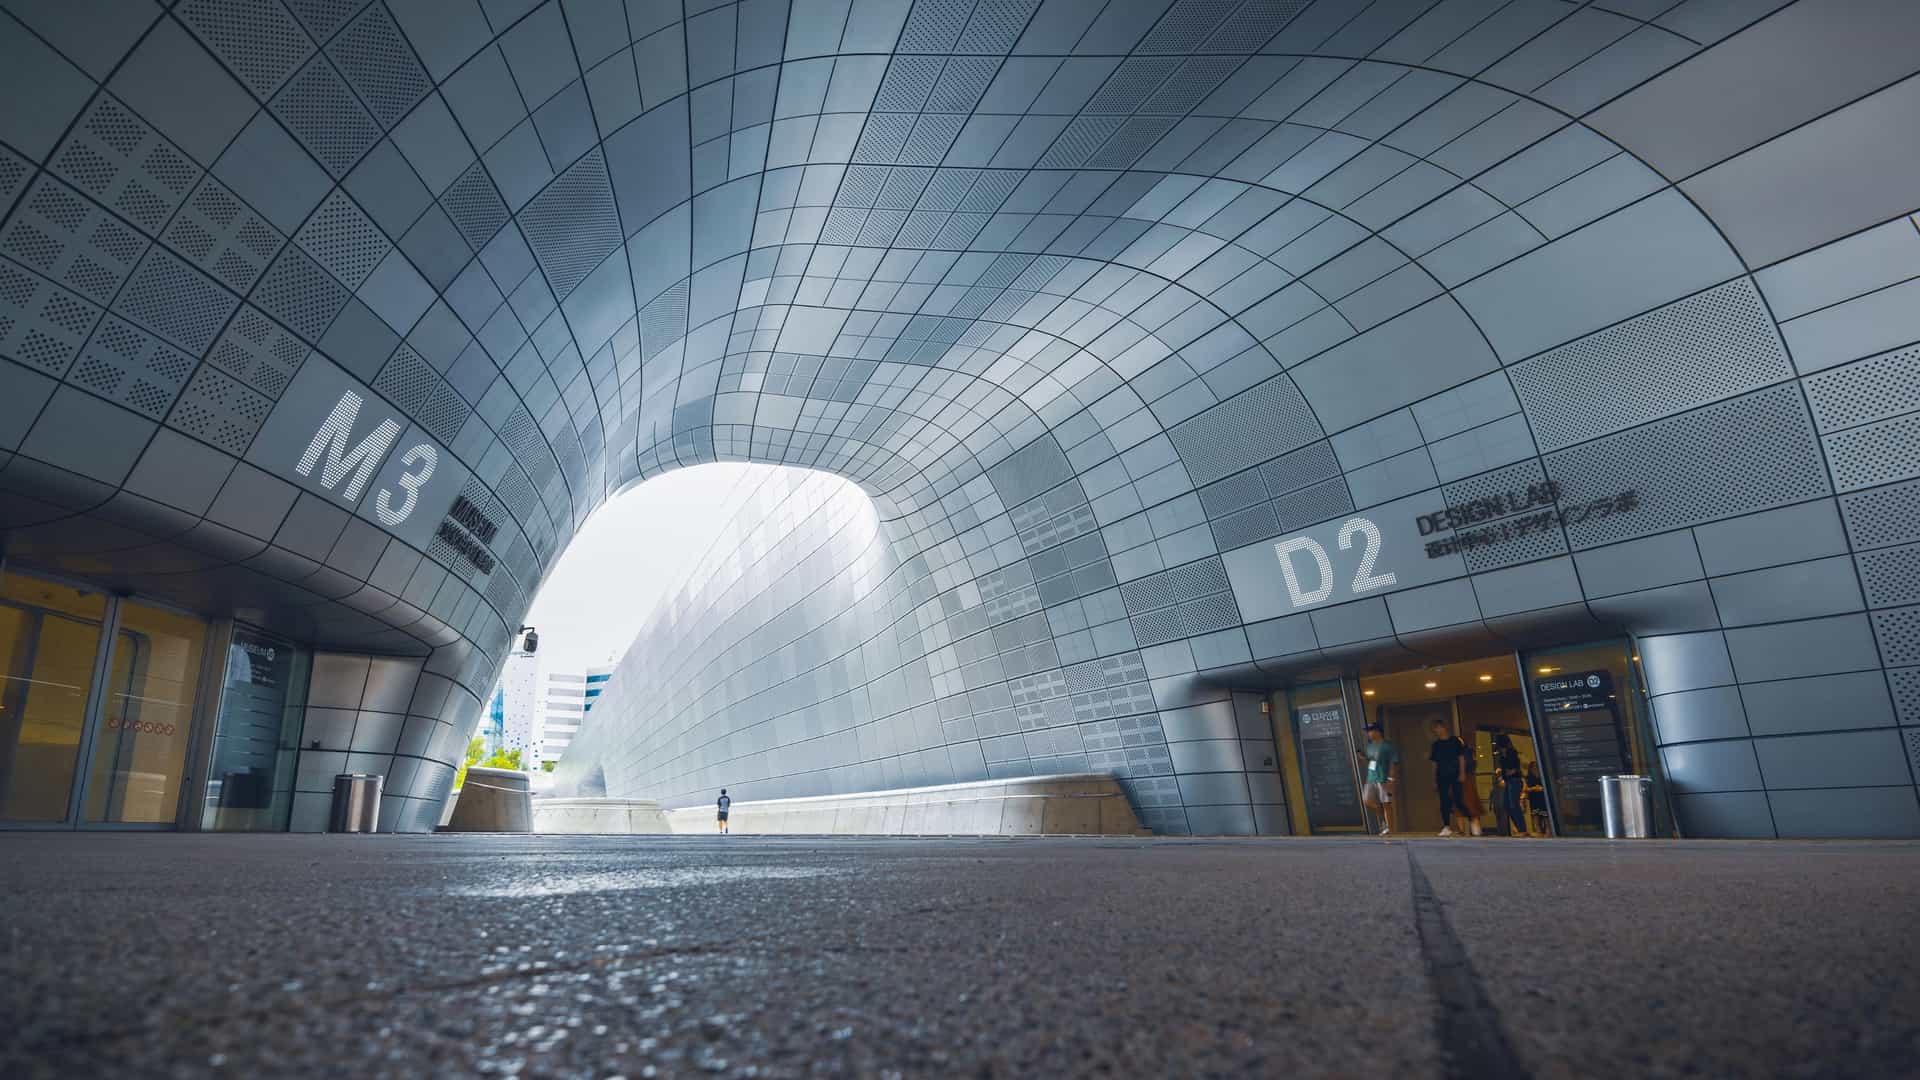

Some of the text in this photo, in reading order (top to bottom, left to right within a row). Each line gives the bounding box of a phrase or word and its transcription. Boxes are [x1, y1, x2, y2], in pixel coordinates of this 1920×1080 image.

[295, 390, 438, 526] M3
[448, 495, 498, 545] MUSEUM
[1416, 479, 1562, 537] DESIGN LAB
[1540, 680, 1568, 692] DESIGN
[1569, 679, 1584, 689] LAB
